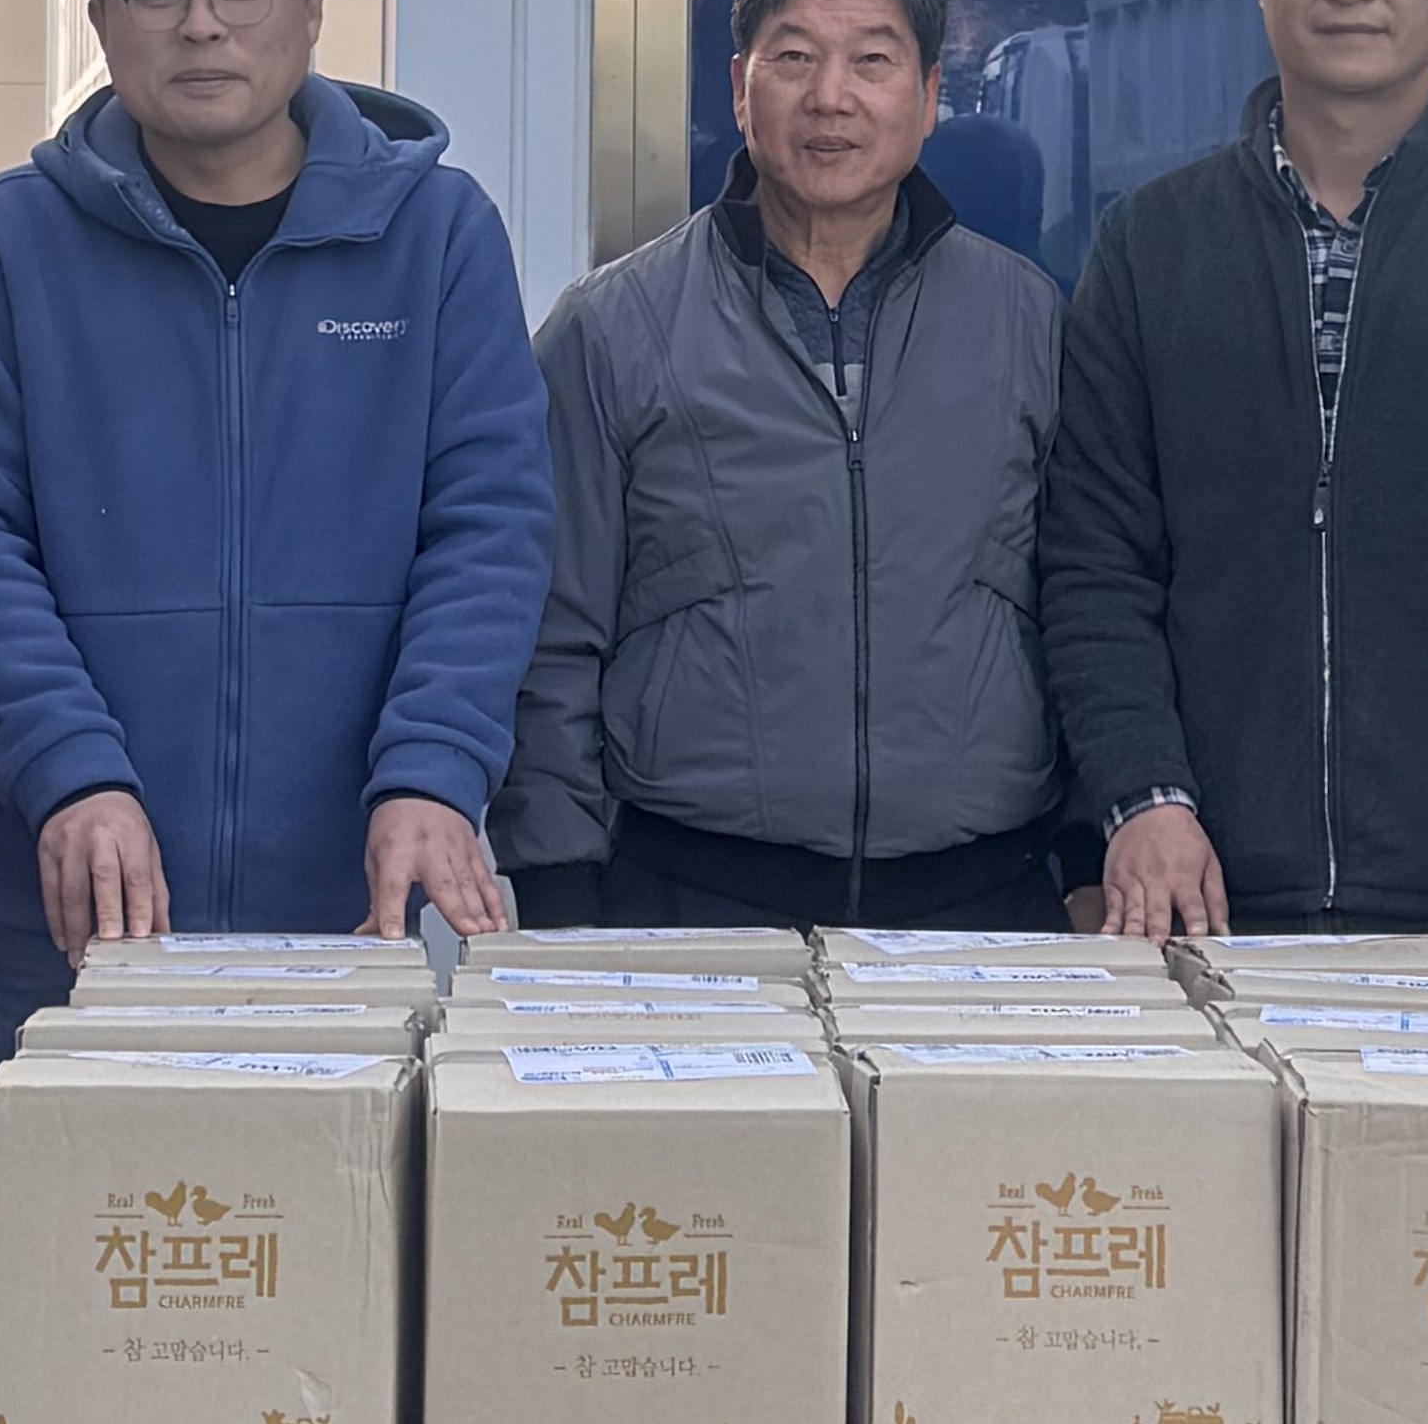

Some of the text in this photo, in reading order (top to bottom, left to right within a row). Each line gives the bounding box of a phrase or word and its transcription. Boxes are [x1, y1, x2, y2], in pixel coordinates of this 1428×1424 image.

[107, 1193, 276, 1209] Real Fresh
[999, 1184, 1163, 1200] Real Fresh
[556, 1214, 725, 1228] Real Fresh
[95, 1225, 278, 1308] 참프레
[986, 1216, 1165, 1298] 참프레
[545, 1246, 727, 1327] 참프레
[1050, 1285, 1135, 1299] CHARMFRE
[158, 1295, 246, 1308] CHARMFRE
[609, 1313, 695, 1326] CHARMFRE
[1017, 1326, 1038, 1350] 참
[124, 1338, 145, 1362] 참
[575, 1355, 596, 1378] 참
